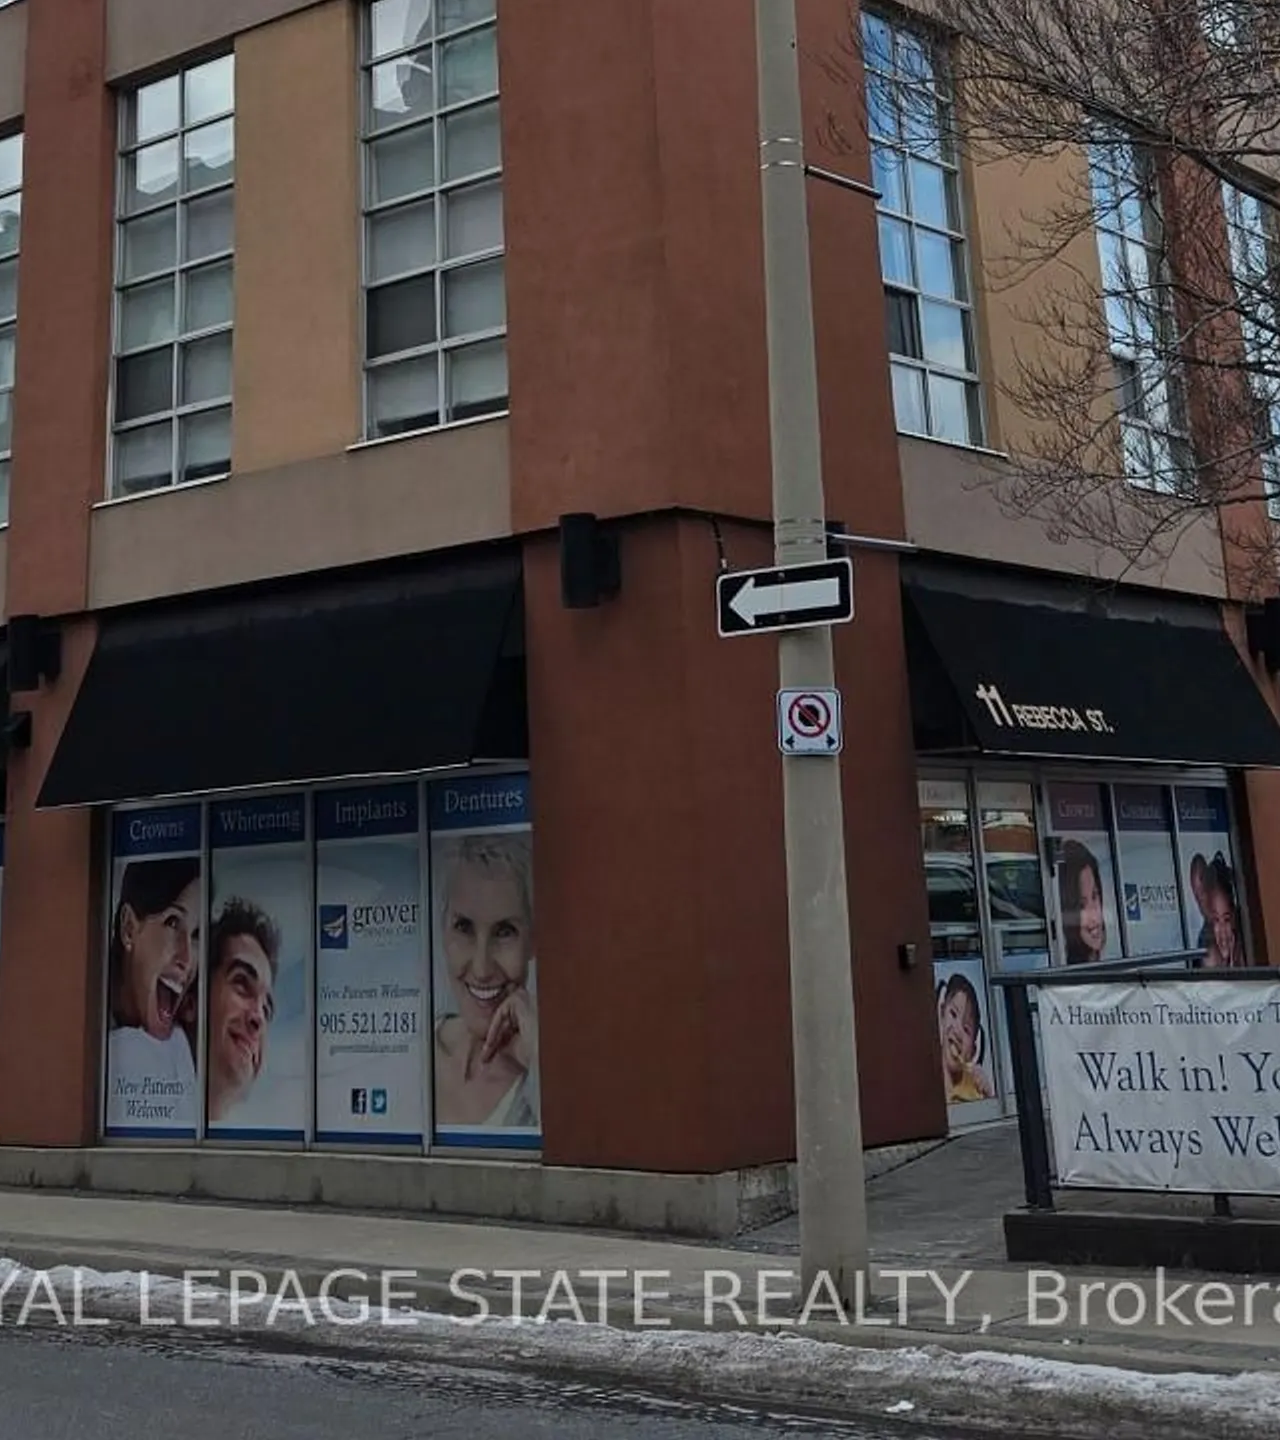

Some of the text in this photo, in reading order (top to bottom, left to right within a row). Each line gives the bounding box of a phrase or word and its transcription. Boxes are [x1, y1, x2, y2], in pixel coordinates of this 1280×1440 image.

[1012, 704, 1090, 732] REBECCA
[1086, 709, 1115, 734] ST.
[335, 798, 408, 829] Implants
[444, 788, 525, 814] Dentures
[129, 818, 185, 842] Crowns
[220, 806, 302, 834] Whitening
[352, 900, 420, 935] grover
[320, 1010, 418, 1035] 905.521.2181
[1050, 1006, 1063, 1026] A
[1068, 1005, 1152, 1026] Hamilton
[1154, 1003, 1239, 1026] Tradition
[1076, 1050, 1170, 1093] Walk
[1179, 1053, 1229, 1093] in!
[1073, 1111, 1204, 1169] Always
